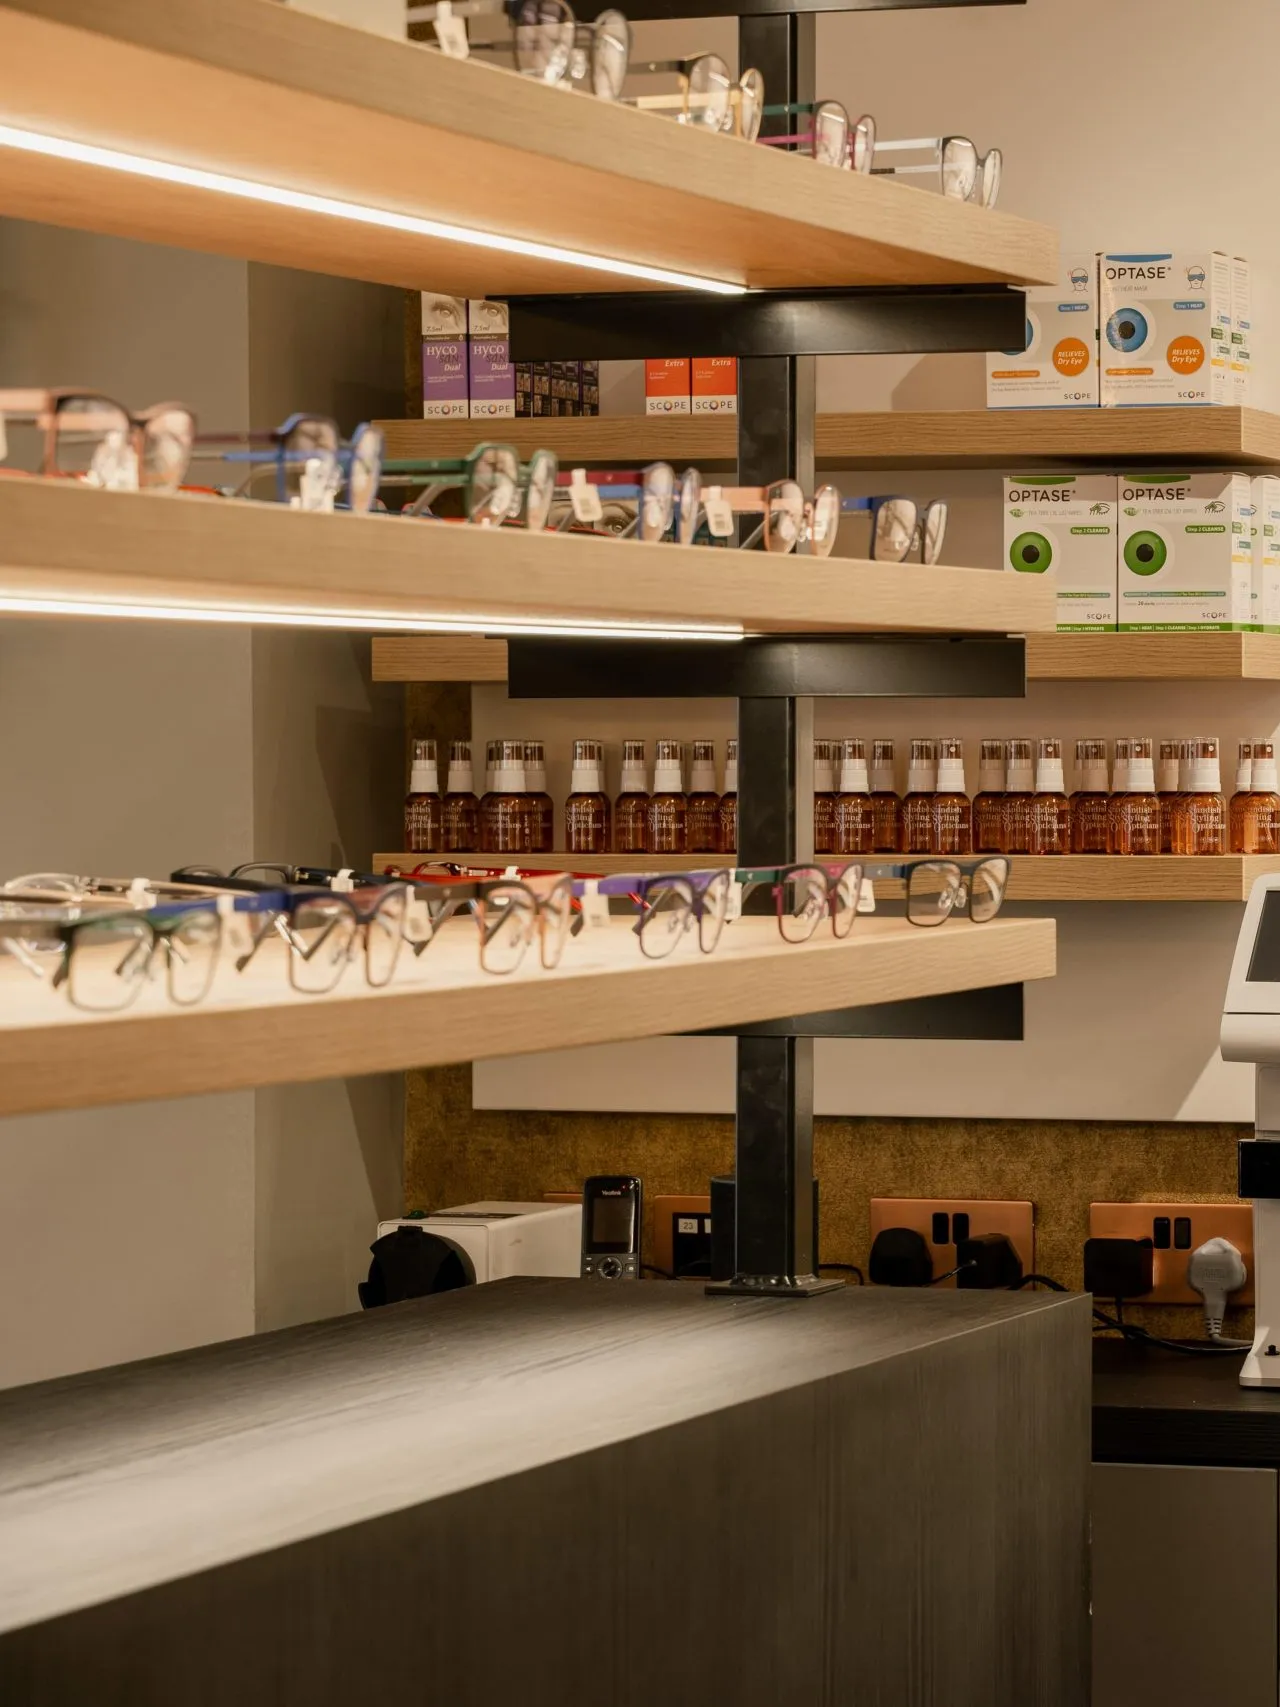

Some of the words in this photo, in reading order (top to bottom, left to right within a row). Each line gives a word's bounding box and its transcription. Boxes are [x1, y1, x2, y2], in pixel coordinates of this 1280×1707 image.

[1171, 348, 1201, 356] RELIEVES
[664, 359, 685, 367] Extra
[711, 359, 732, 367] Extra
[1070, 357, 1083, 365] Eye
[444, 363, 462, 372] Dual
[491, 363, 508, 371] Dual
[1064, 392, 1092, 400] SCOPE
[1177, 391, 1206, 399] SCOPE
[473, 404, 512, 414] SCOPE
[649, 401, 687, 411] SCOPE
[695, 400, 733, 411] SCOPE
[427, 405, 464, 415] SCOPE
[683, 1222, 694, 1230] 23
